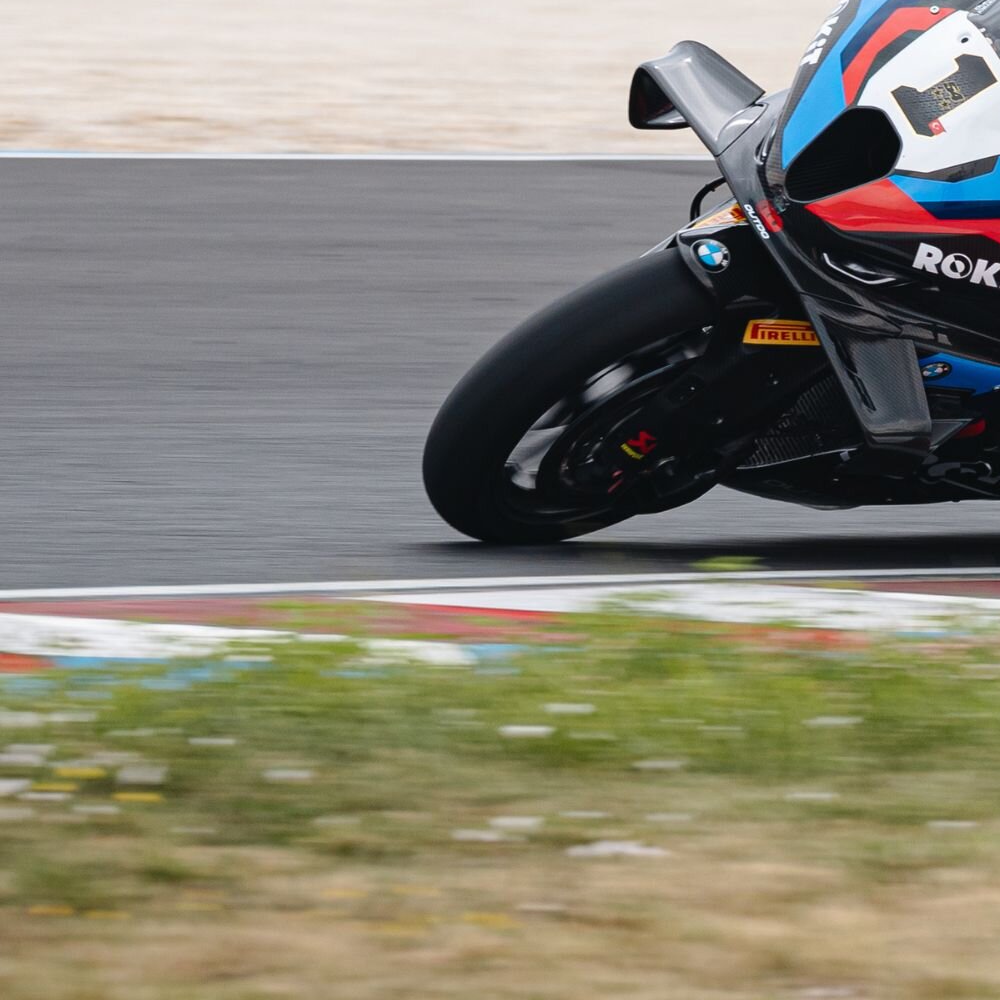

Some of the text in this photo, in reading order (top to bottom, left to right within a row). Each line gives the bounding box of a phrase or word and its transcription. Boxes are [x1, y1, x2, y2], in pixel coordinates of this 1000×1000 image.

[890, 53, 998, 137] 1
[743, 203, 770, 240] OUTDO
[751, 322, 817, 341] PIRELLI
